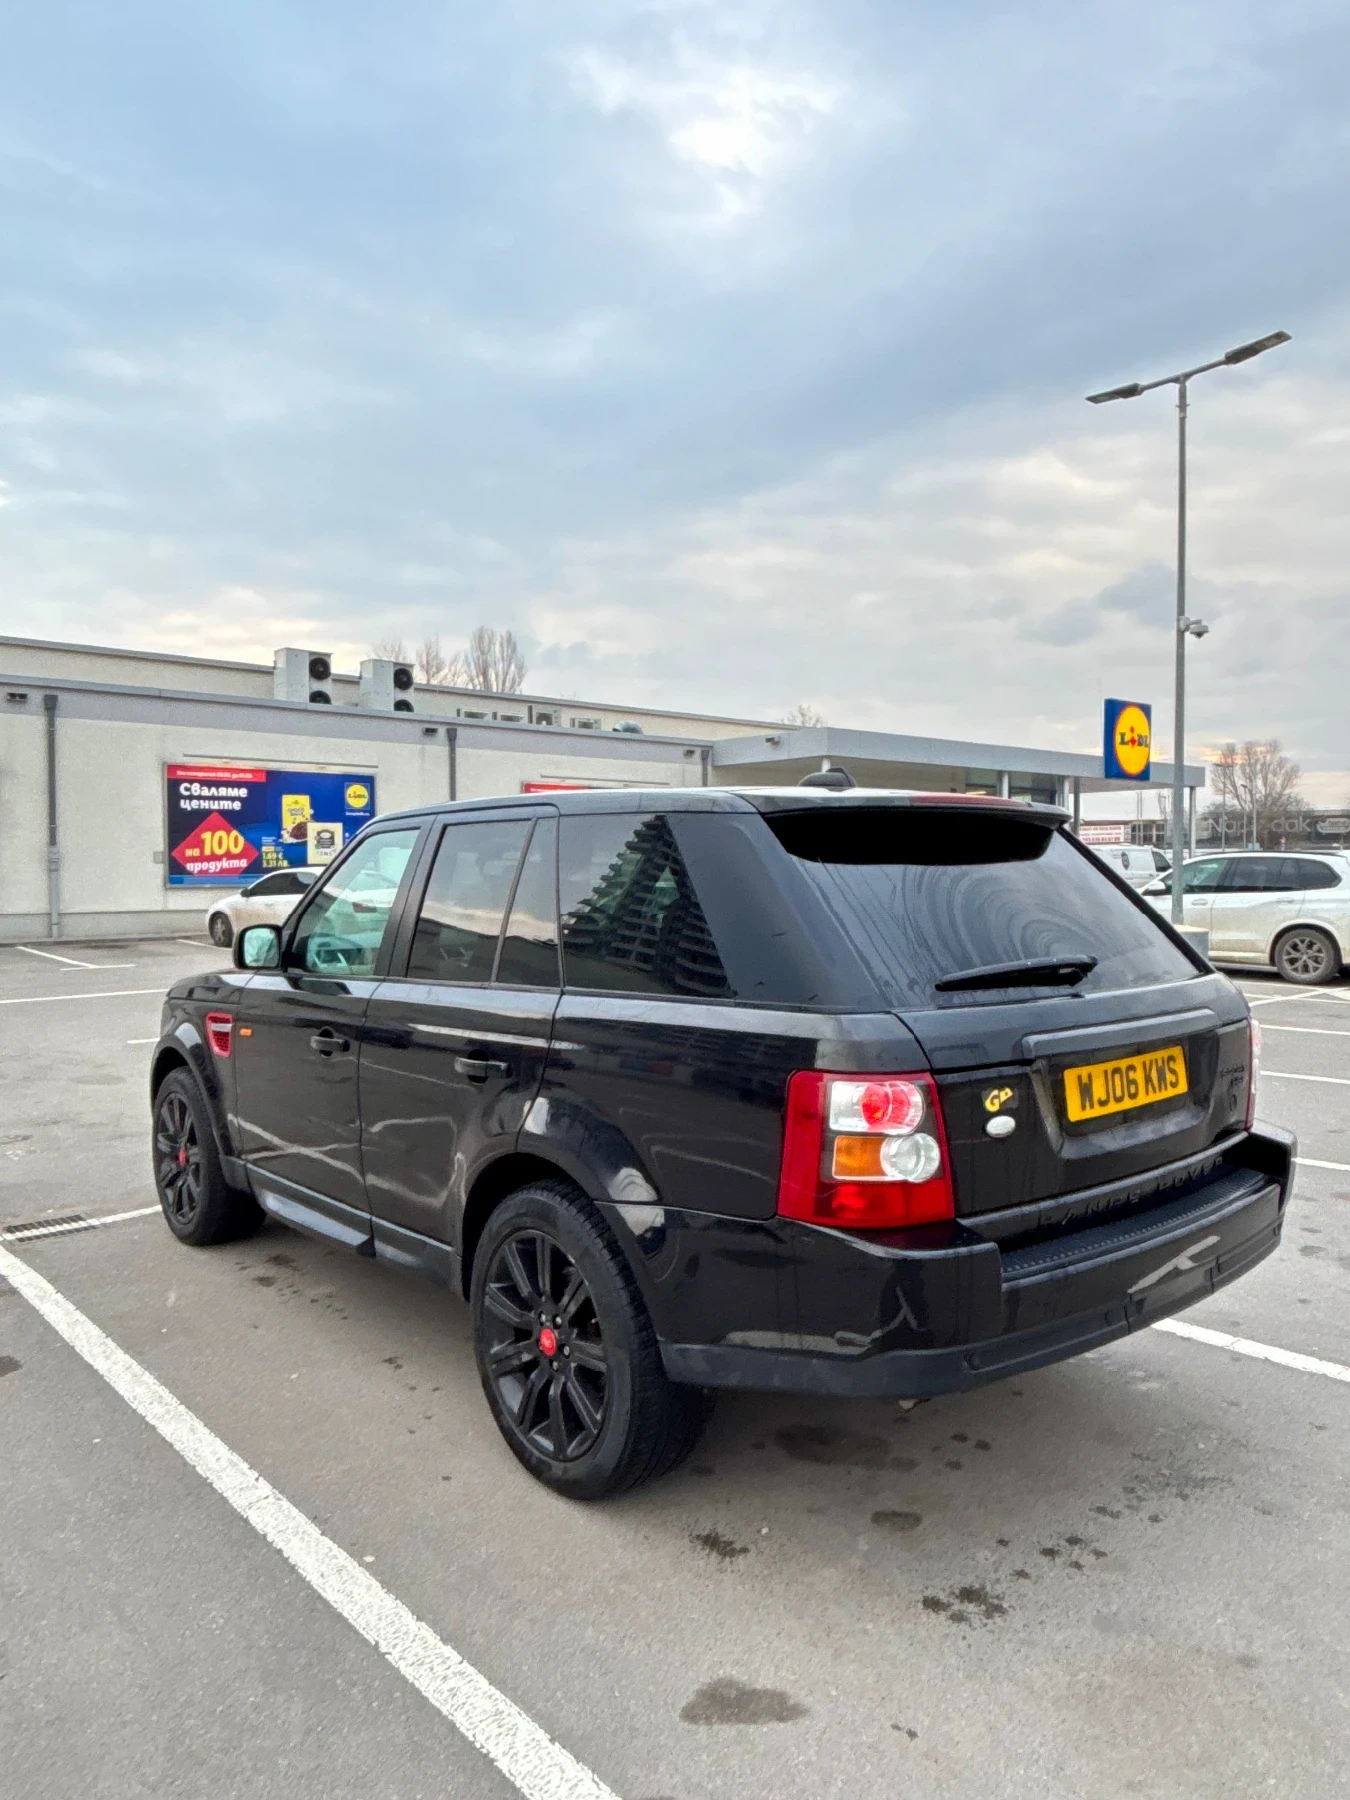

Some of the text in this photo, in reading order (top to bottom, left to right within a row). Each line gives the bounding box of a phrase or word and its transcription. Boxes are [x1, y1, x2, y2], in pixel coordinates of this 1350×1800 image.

[179, 782, 248, 798] Сваляме
[180, 799, 242, 811] цените
[185, 848, 200, 857] на
[201, 829, 245, 856] 100
[186, 857, 248, 874] продукта
[1078, 1055, 1179, 1112] WJ06 KWS
